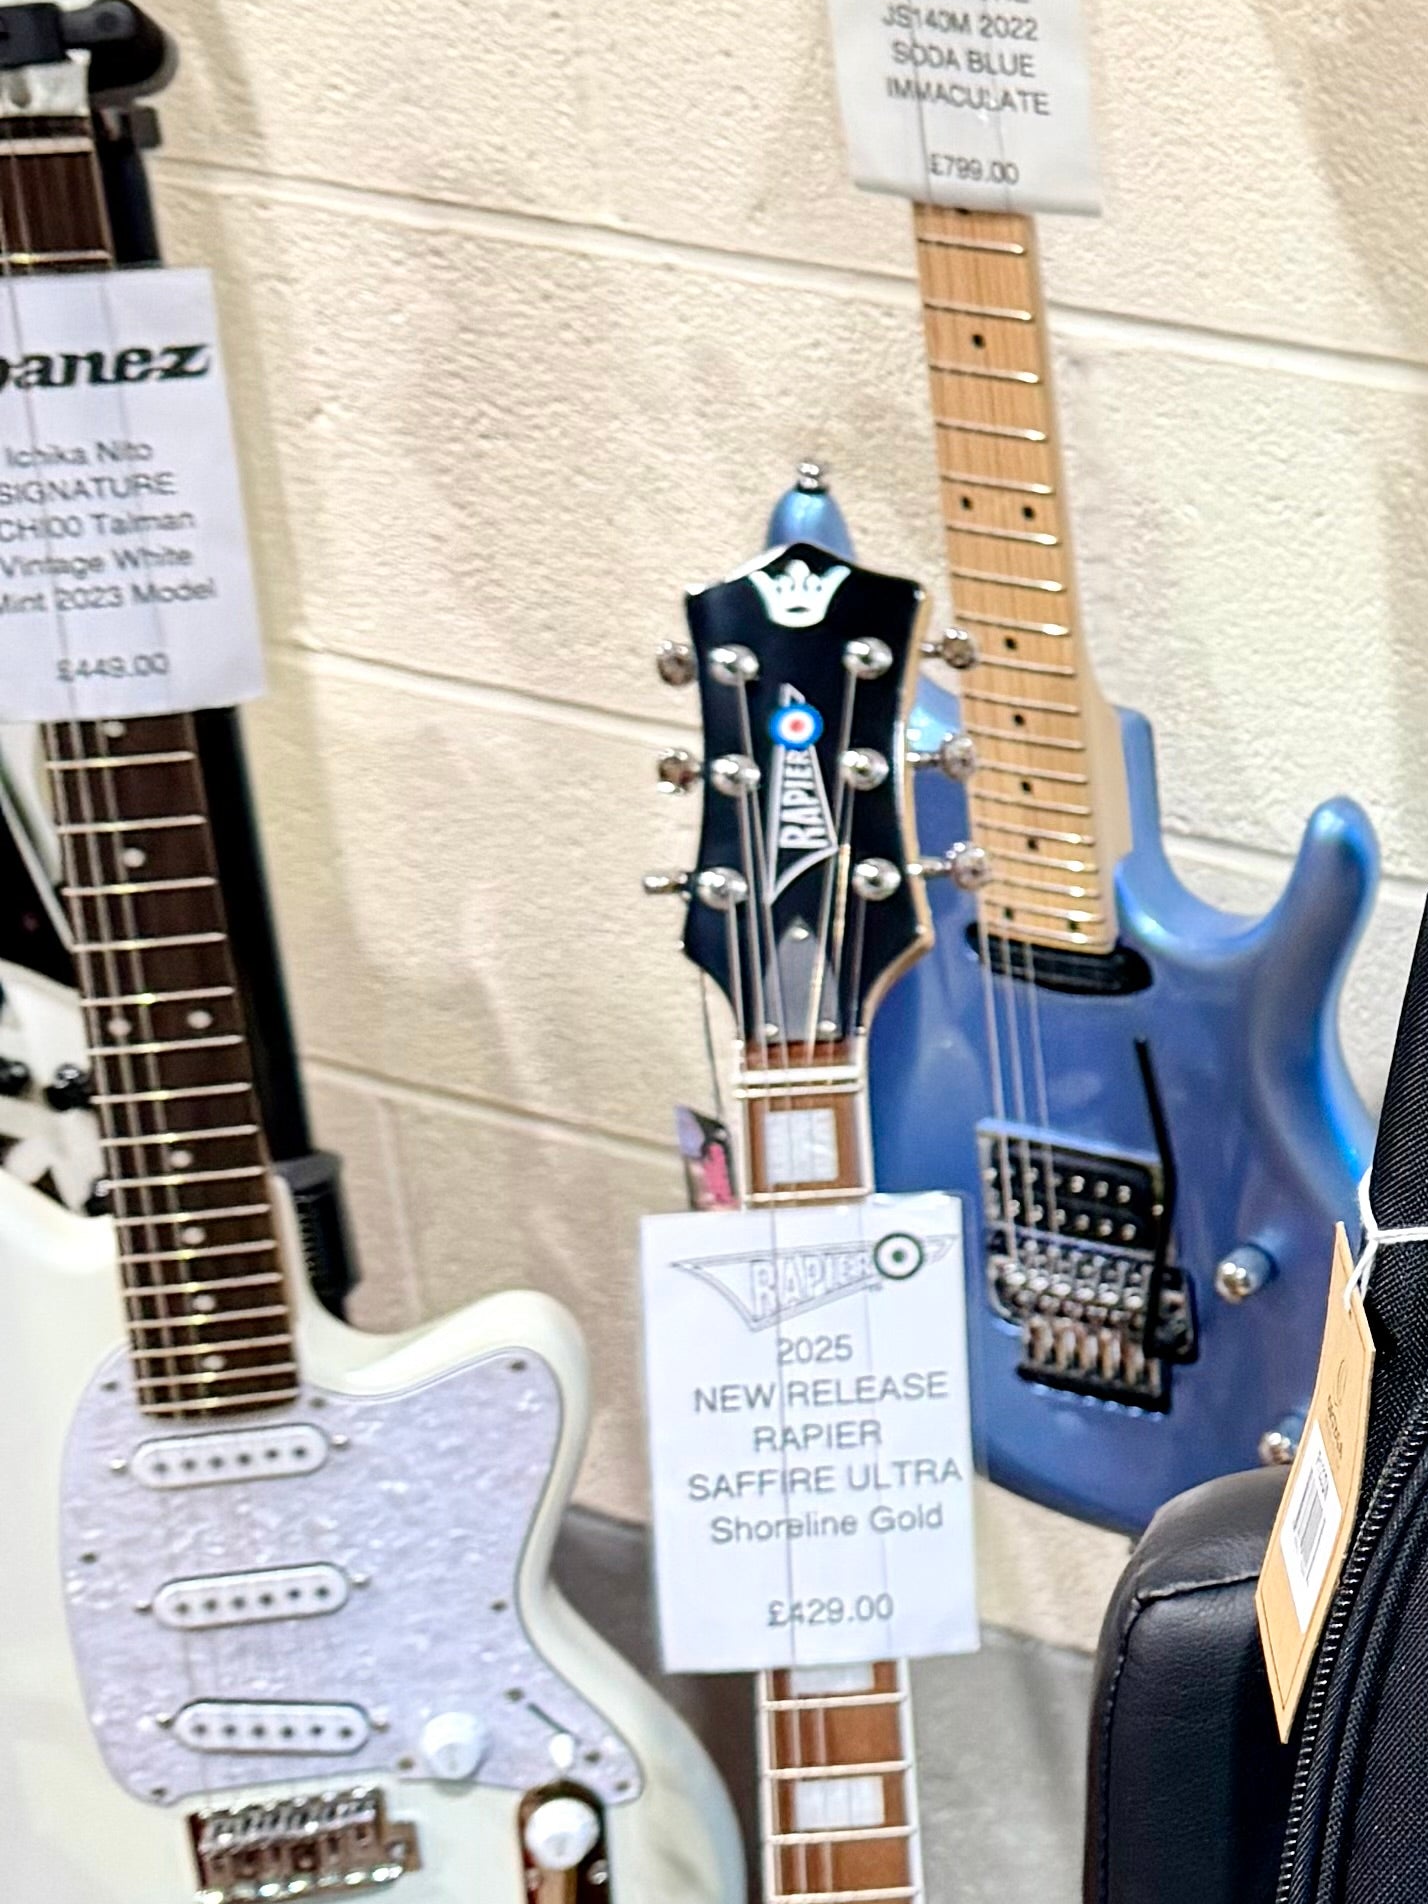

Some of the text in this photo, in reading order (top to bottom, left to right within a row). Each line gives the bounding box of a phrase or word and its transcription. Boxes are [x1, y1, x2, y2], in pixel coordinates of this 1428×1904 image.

[979, 13, 1039, 42] 2022
[891, 40, 1036, 78] SODA BLUE
[886, 76, 1051, 117] IMMACULATE
[930, 152, 1020, 185] £799.00
[0, 342, 210, 393] anez
[112, 545, 194, 570] White
[55, 585, 124, 612] 2023
[131, 577, 217, 604] Model
[779, 749, 829, 851] RAPIER
[751, 1250, 872, 1321] RAPIER
[778, 1334, 854, 1366] 2025
[693, 1370, 949, 1413] NEW RELEASE
[753, 1419, 883, 1454] RAPIER
[687, 1456, 963, 1502] SAFFIRE ULTRA
[710, 1501, 944, 1545] Shoreline Gold
[766, 1592, 895, 1629] £429.00
